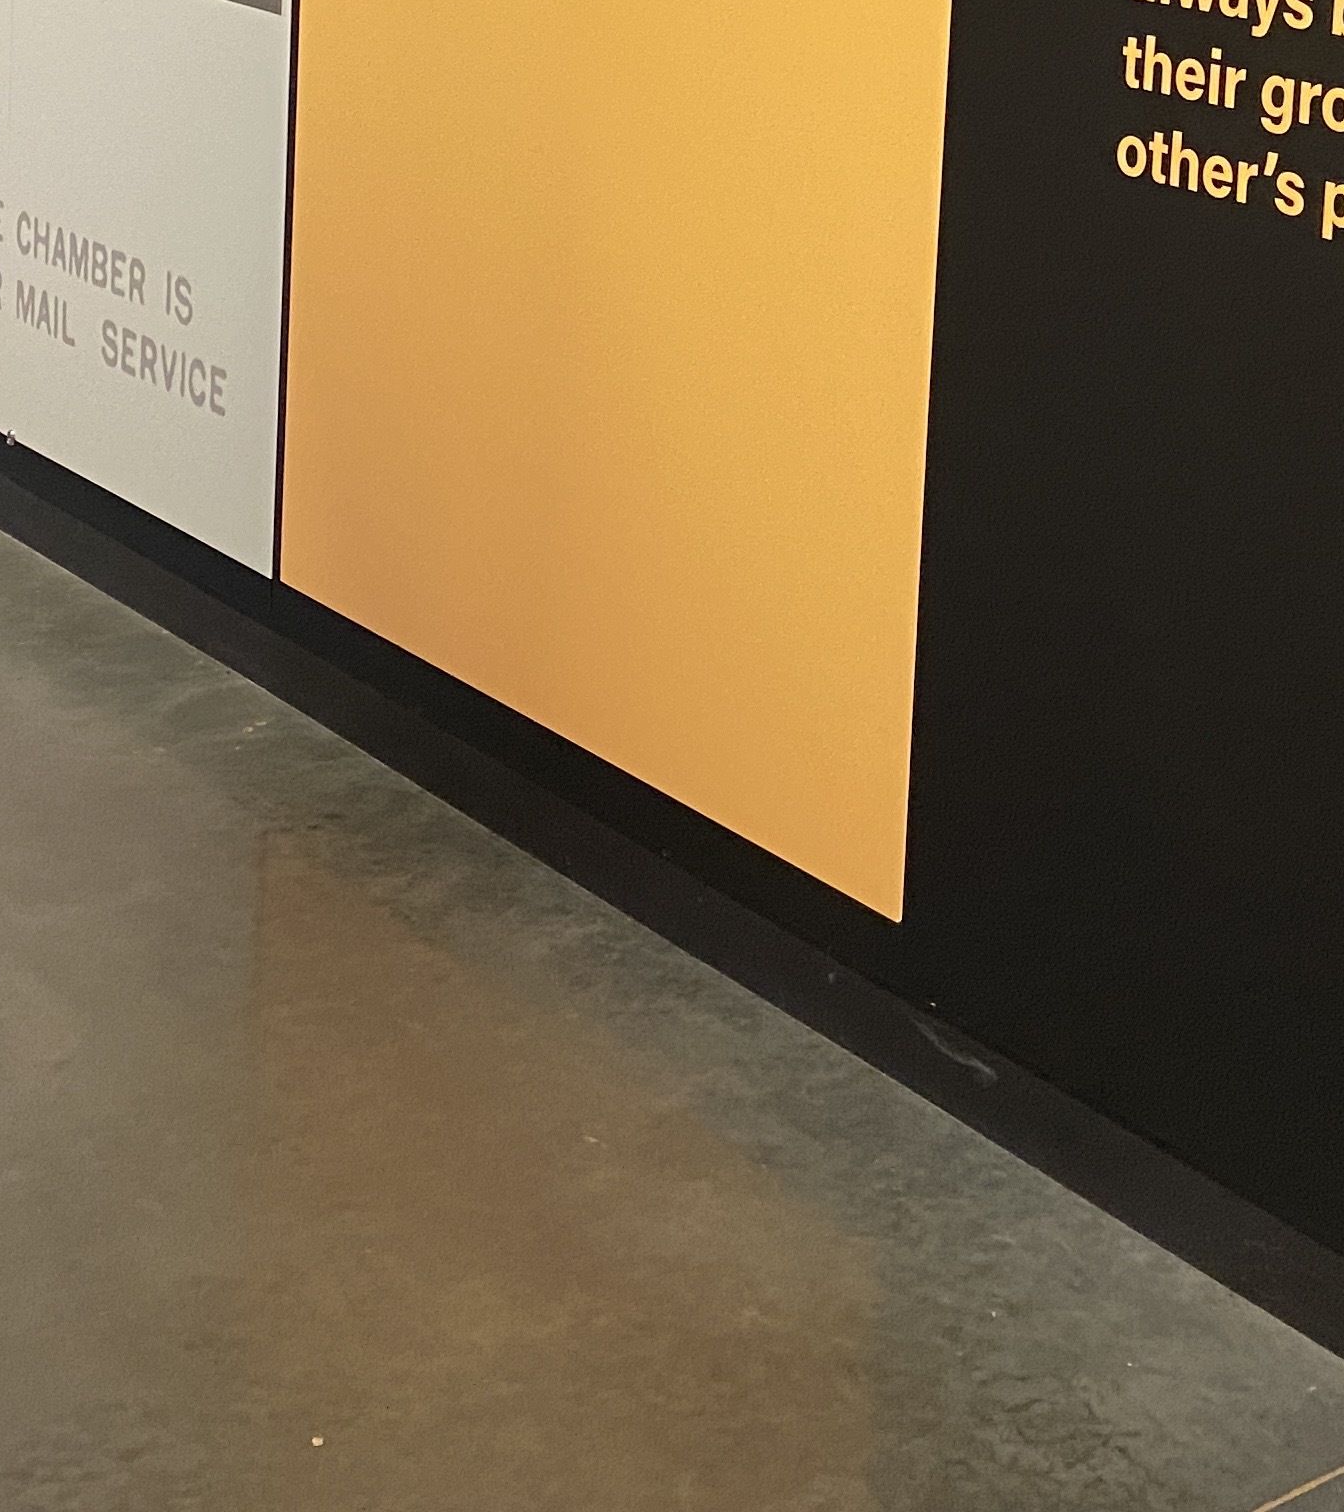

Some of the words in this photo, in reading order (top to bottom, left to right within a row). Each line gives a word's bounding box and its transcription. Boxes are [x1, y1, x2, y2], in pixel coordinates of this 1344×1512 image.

[1122, 34, 1247, 109] their
[1116, 130, 1305, 217] other's
[16, 210, 146, 307] CHAMBER
[164, 269, 194, 327] IS
[15, 279, 77, 348] MAIL
[100, 318, 228, 418] SERVICE
